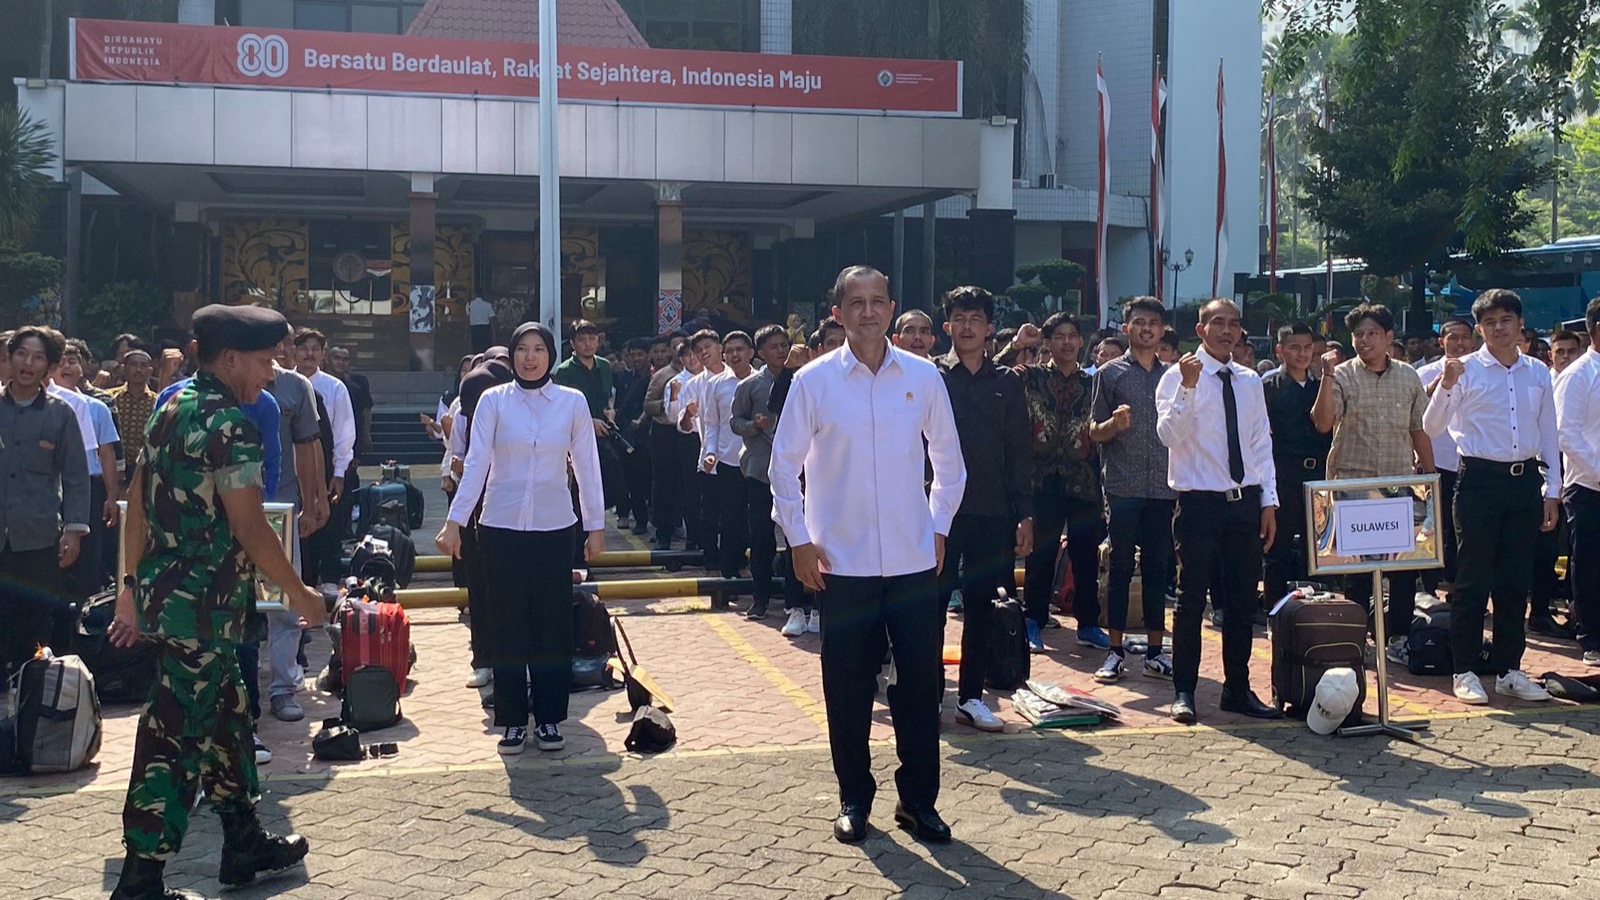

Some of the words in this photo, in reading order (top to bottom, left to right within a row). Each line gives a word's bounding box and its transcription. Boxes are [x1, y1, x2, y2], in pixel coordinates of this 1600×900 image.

[104, 45, 155, 55] REPUBLIK
[237, 34, 289, 77] 80
[104, 56, 161, 66] INDONESIA
[304, 48, 386, 71] Bersatu
[392, 52, 497, 78] Berdaulat,
[503, 57, 572, 80] Rakat
[577, 61, 677, 86] Sejahtera,
[682, 66, 774, 88] Indonesia
[779, 69, 822, 94] Maju
[1350, 520, 1399, 533] SULAWESI
